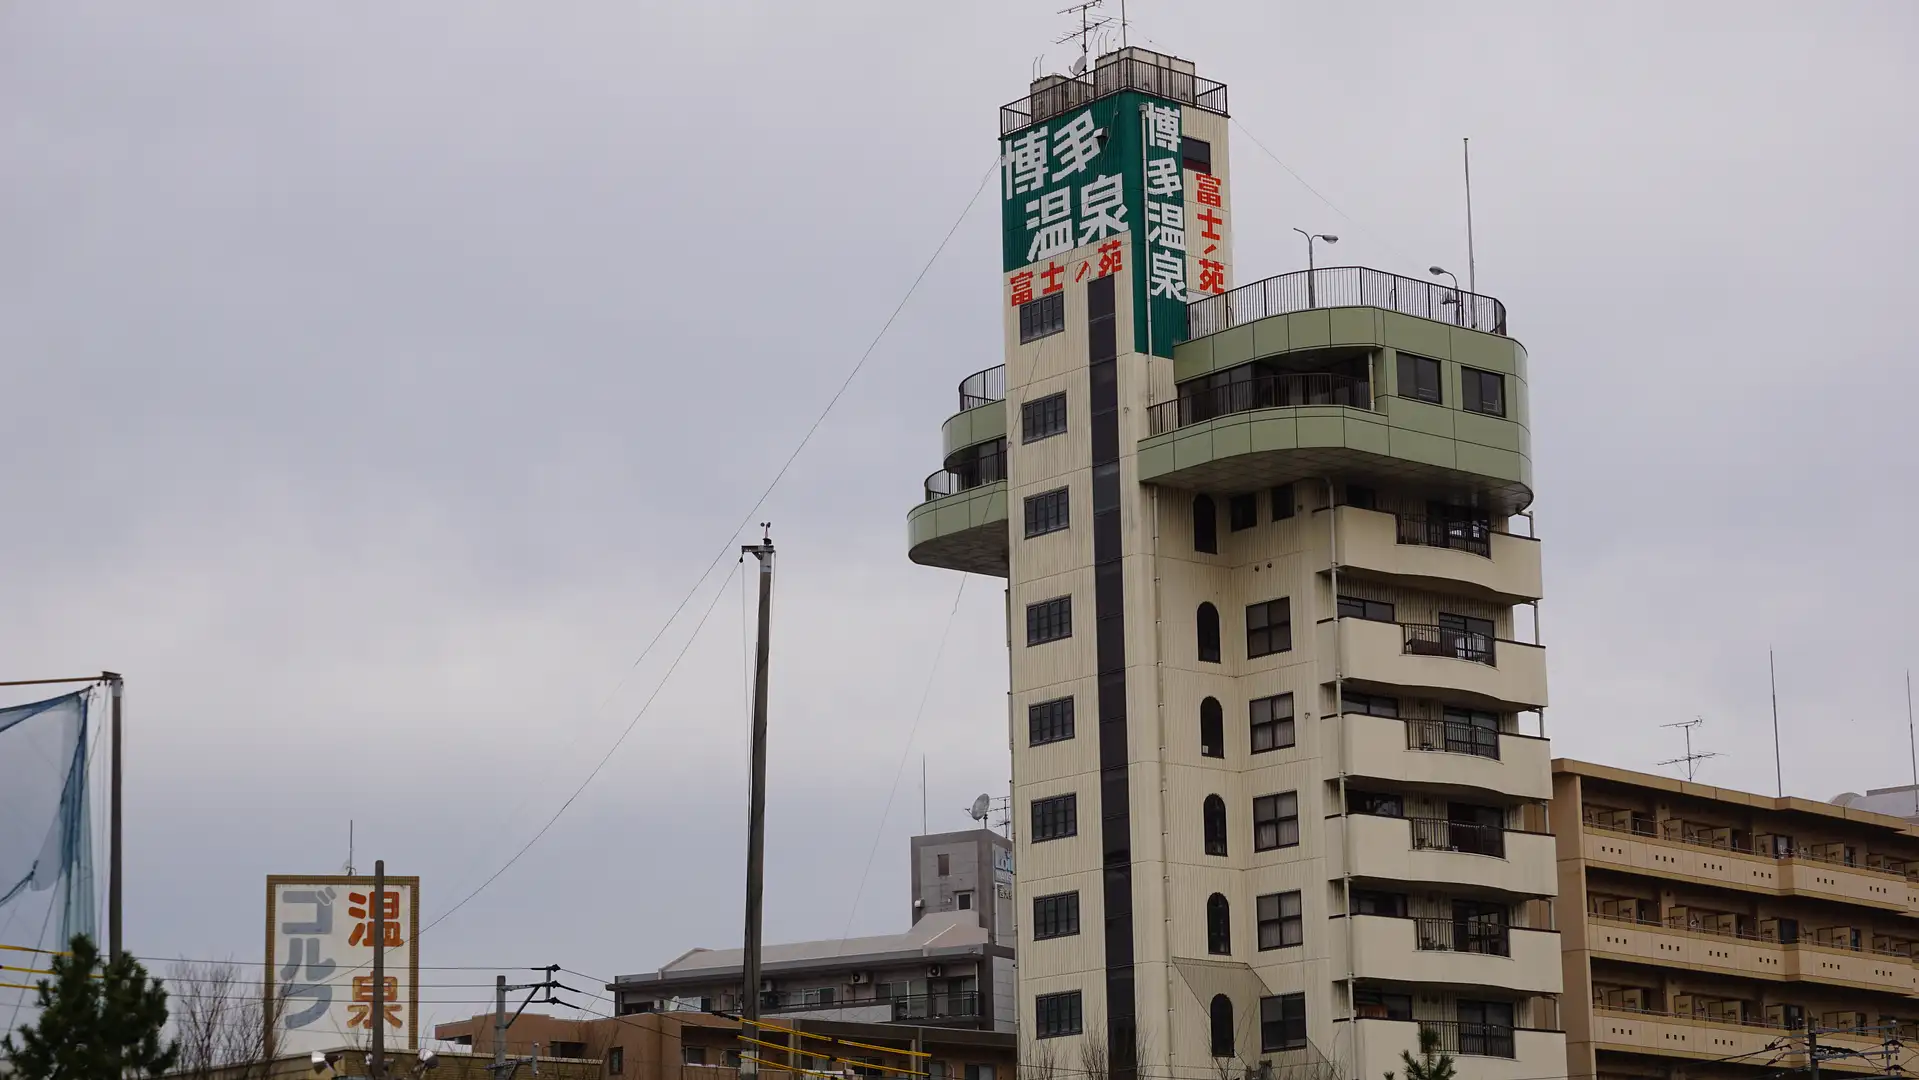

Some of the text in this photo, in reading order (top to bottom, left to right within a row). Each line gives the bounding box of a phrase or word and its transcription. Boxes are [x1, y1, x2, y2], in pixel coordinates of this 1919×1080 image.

[1001, 110, 1102, 200] 博多
[1026, 172, 1129, 263] 温泉
[1146, 102, 1188, 302] 博多温泉
[280, 886, 337, 1030] ゴルフ
[347, 891, 405, 1030] 温泉
